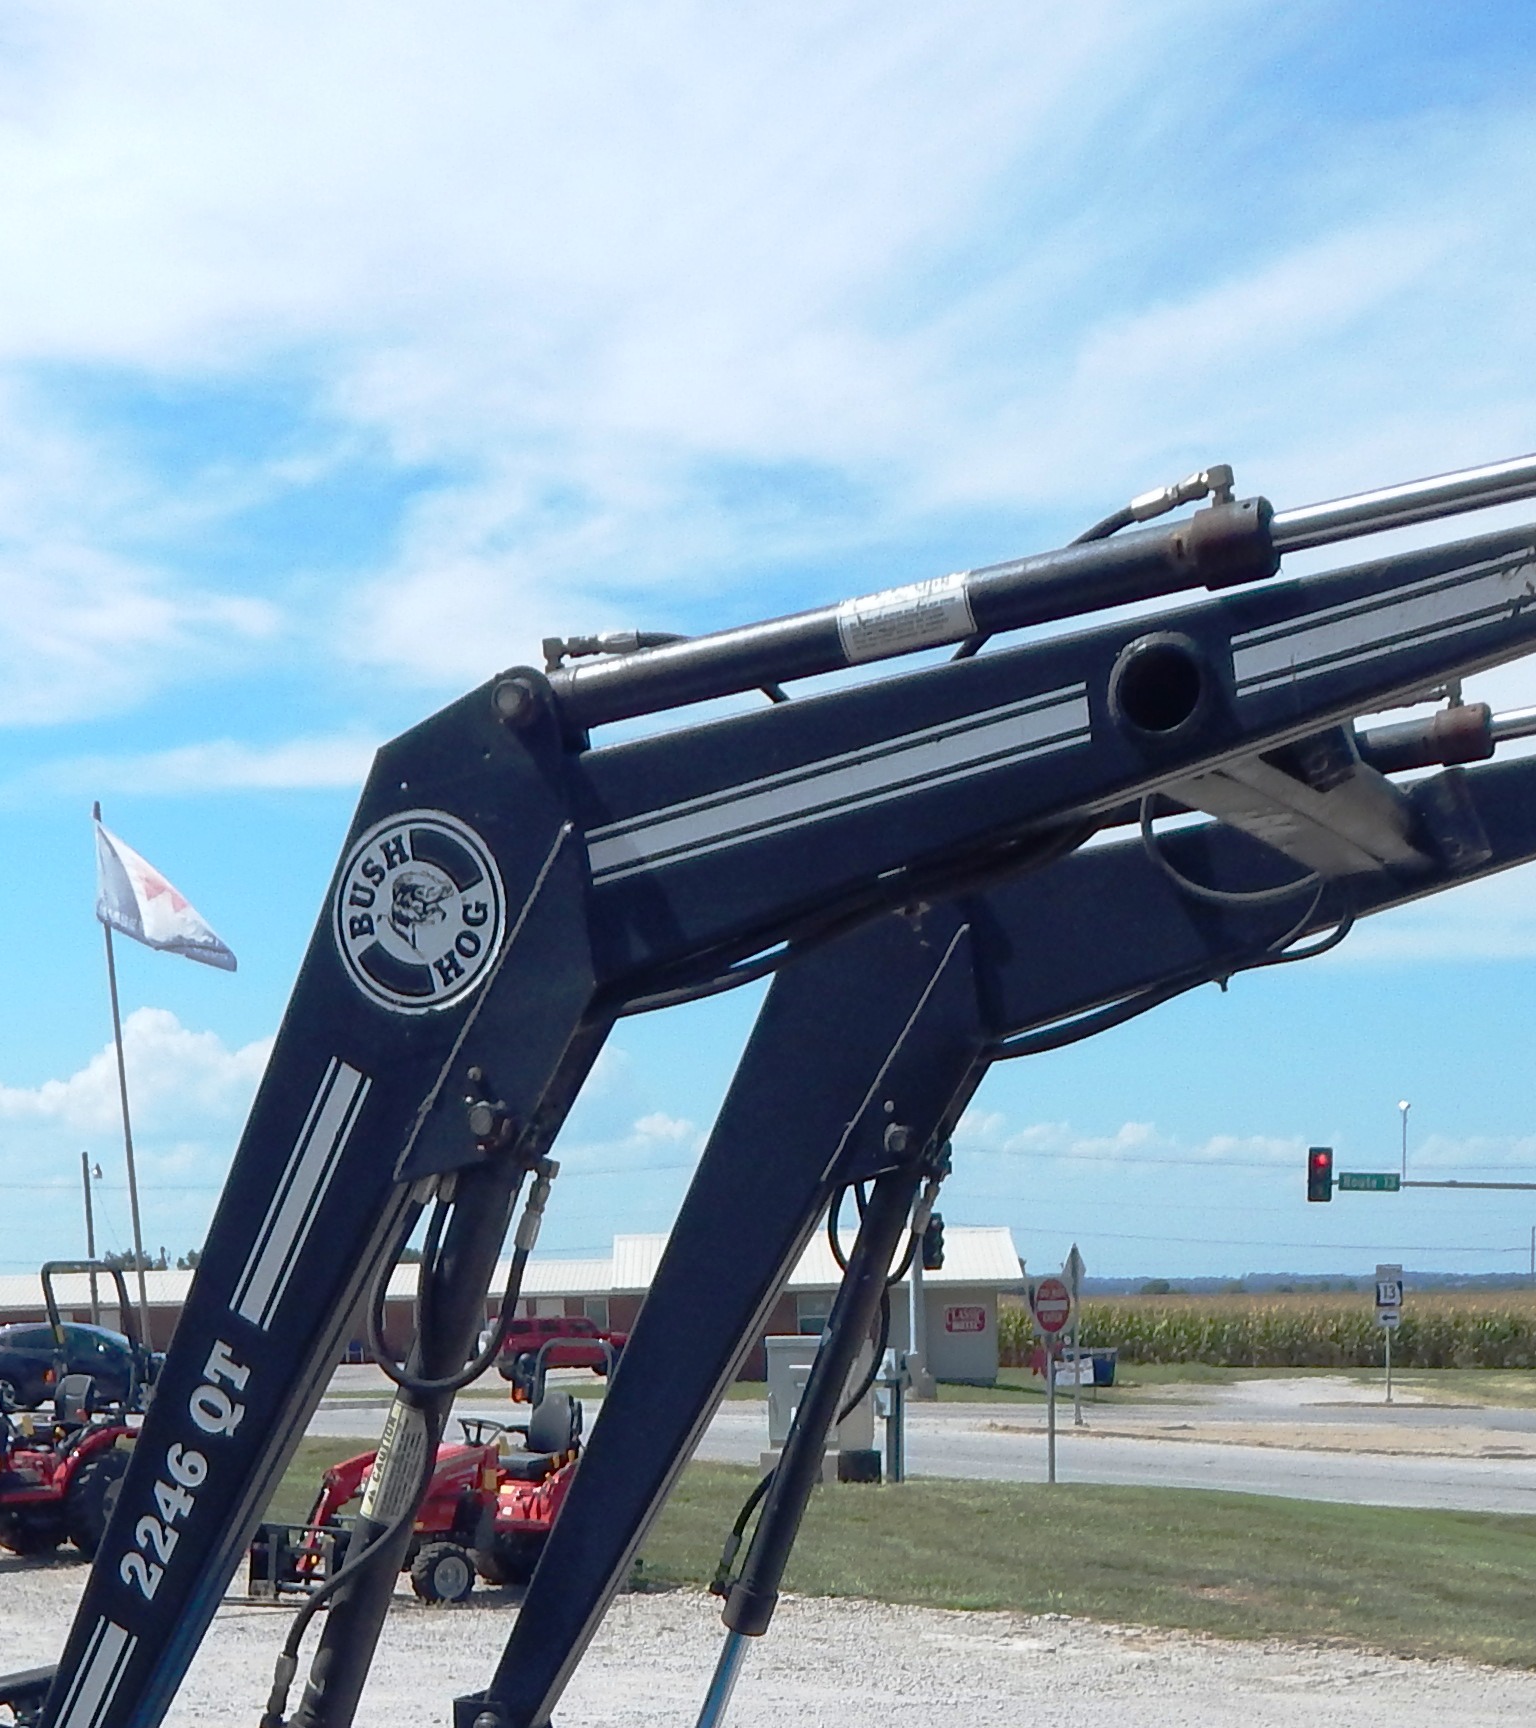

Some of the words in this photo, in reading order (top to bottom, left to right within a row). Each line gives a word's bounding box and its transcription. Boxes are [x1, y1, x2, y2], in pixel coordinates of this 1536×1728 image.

[349, 834, 411, 940] BUSH
[433, 900, 489, 987] HOG
[1342, 1175, 1378, 1189] Route
[1384, 1177, 1397, 1189] 13
[1383, 1284, 1396, 1300] 13
[120, 1442, 208, 1601] 2246
[189, 1339, 251, 1437] QT
[372, 1416, 398, 1483] CAUTION
